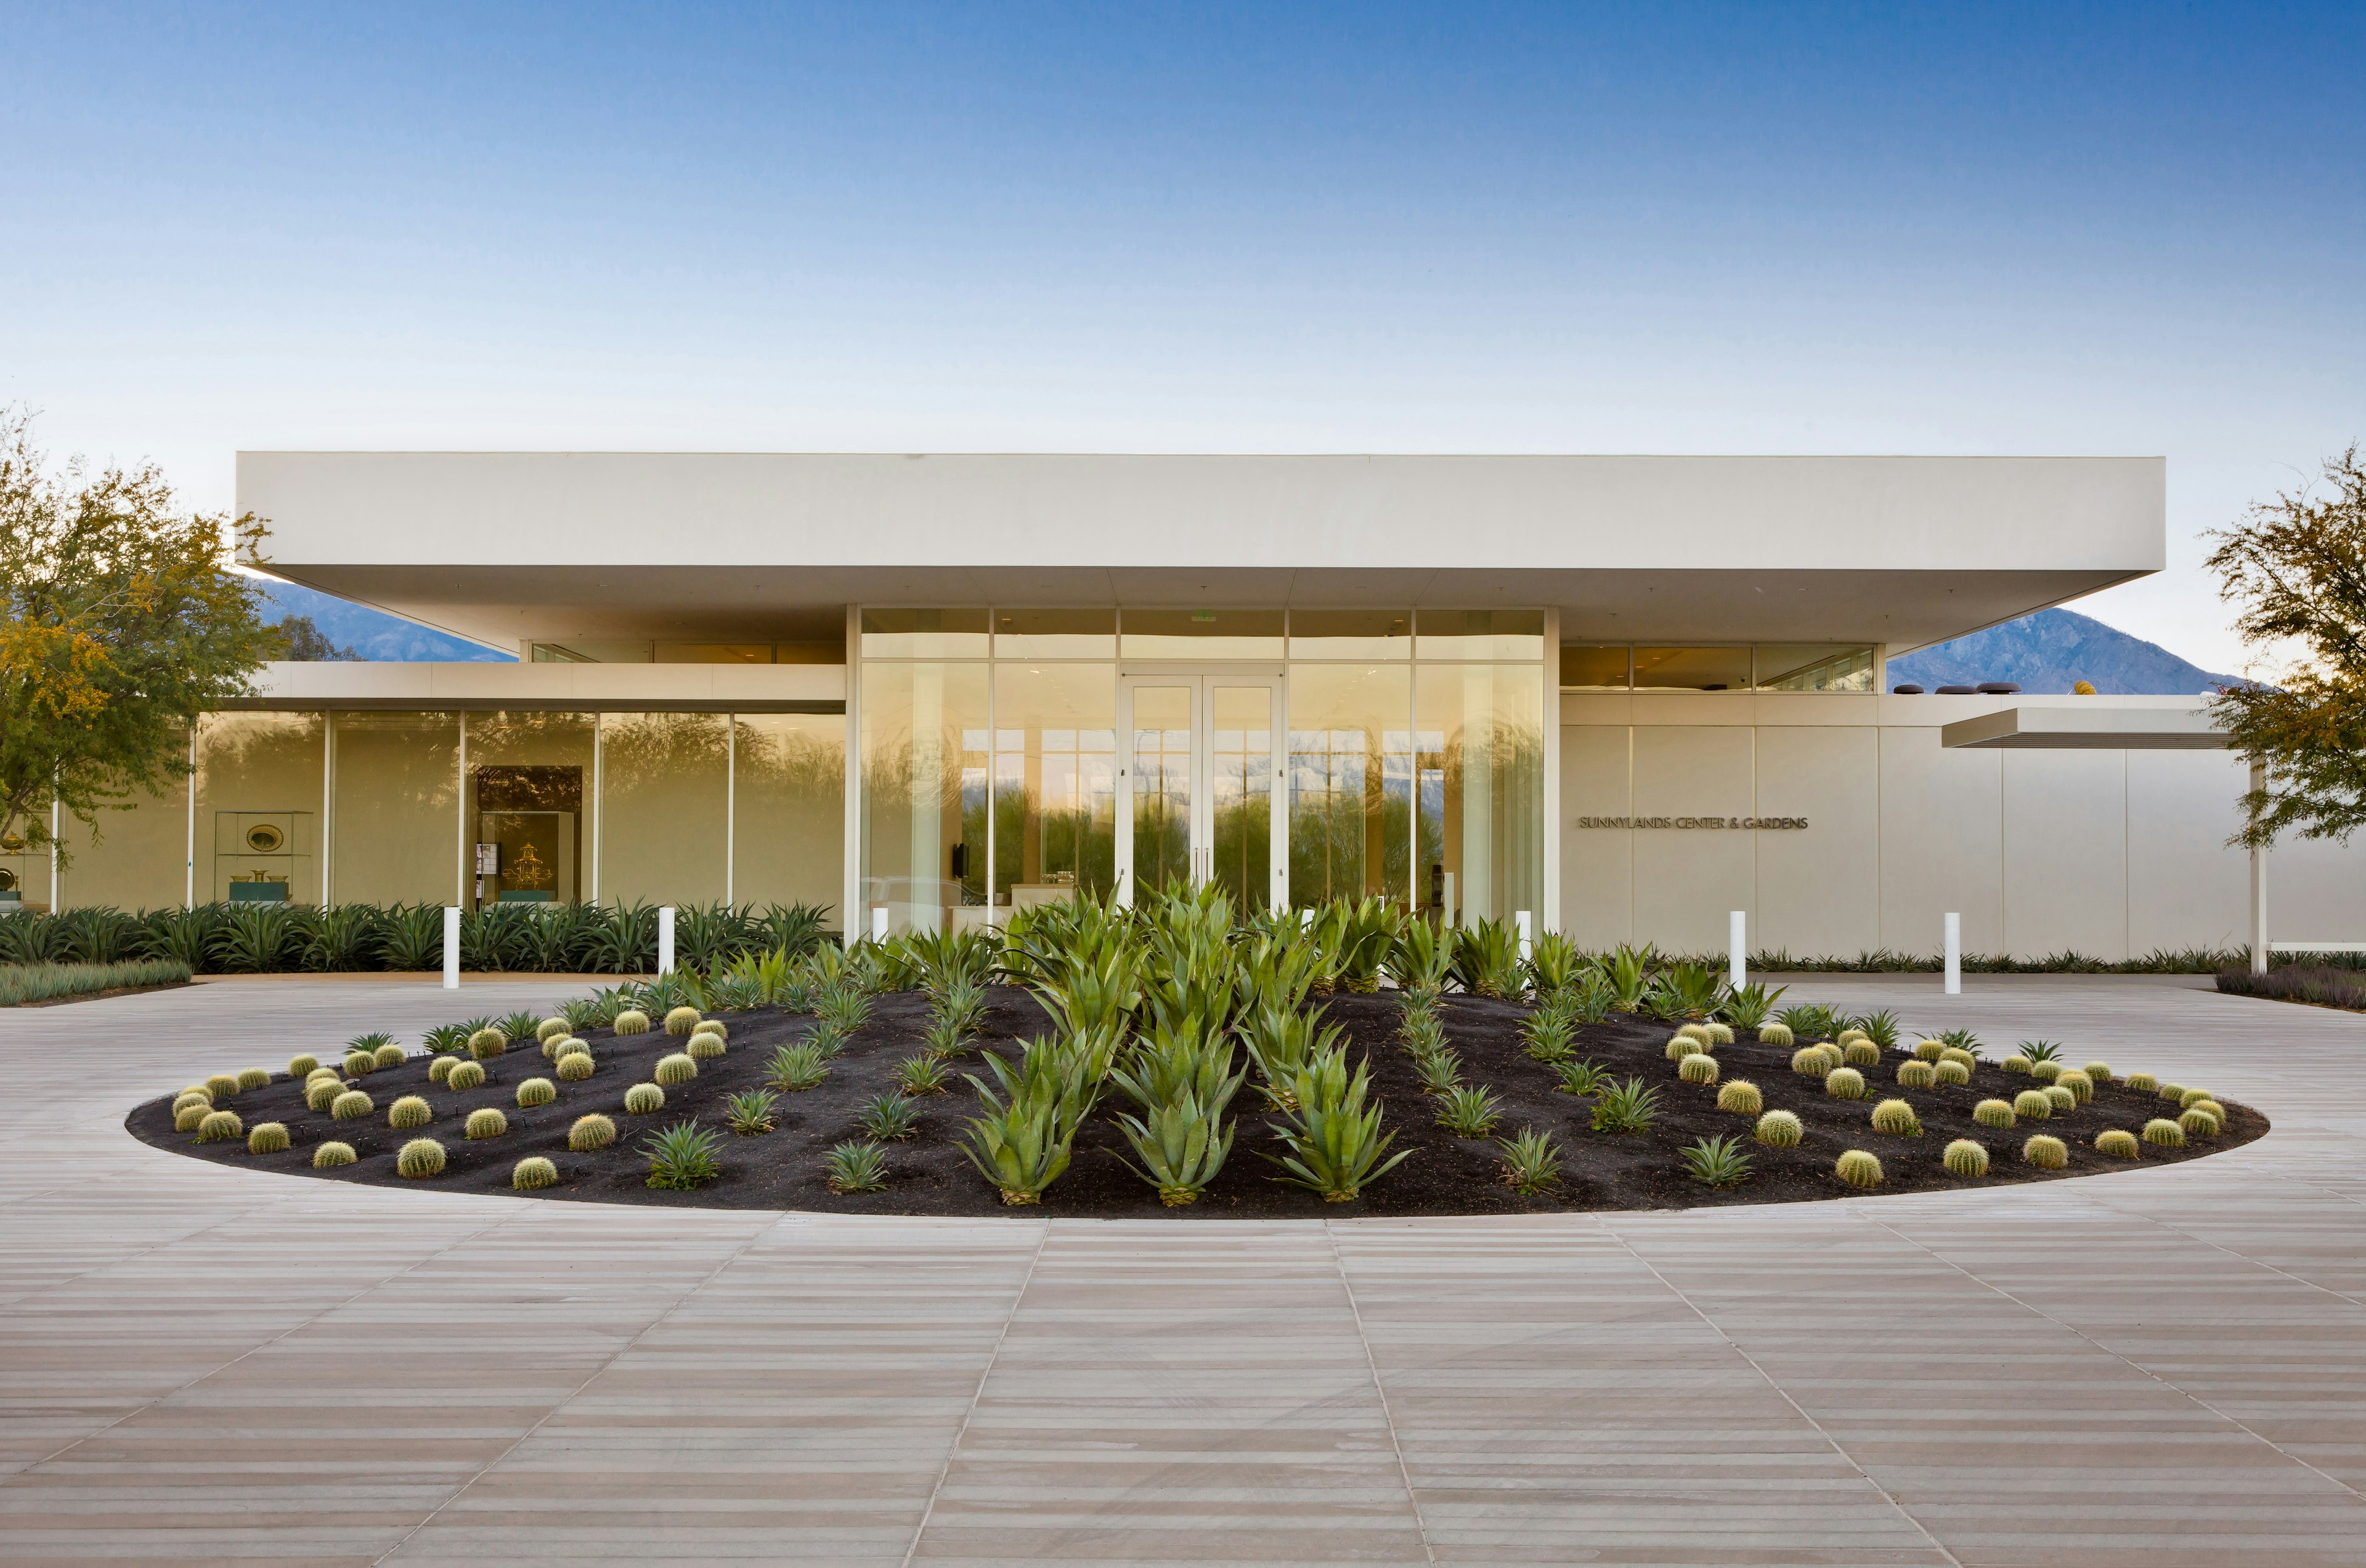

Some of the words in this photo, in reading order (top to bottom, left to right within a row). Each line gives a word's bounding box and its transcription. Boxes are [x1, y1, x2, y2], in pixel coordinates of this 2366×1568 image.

[1580, 816, 1671, 829] SUNNYLANDS
[1676, 816, 1725, 829] CENTER
[1730, 817, 1739, 829] &
[1744, 817, 1808, 829] GARDENS
